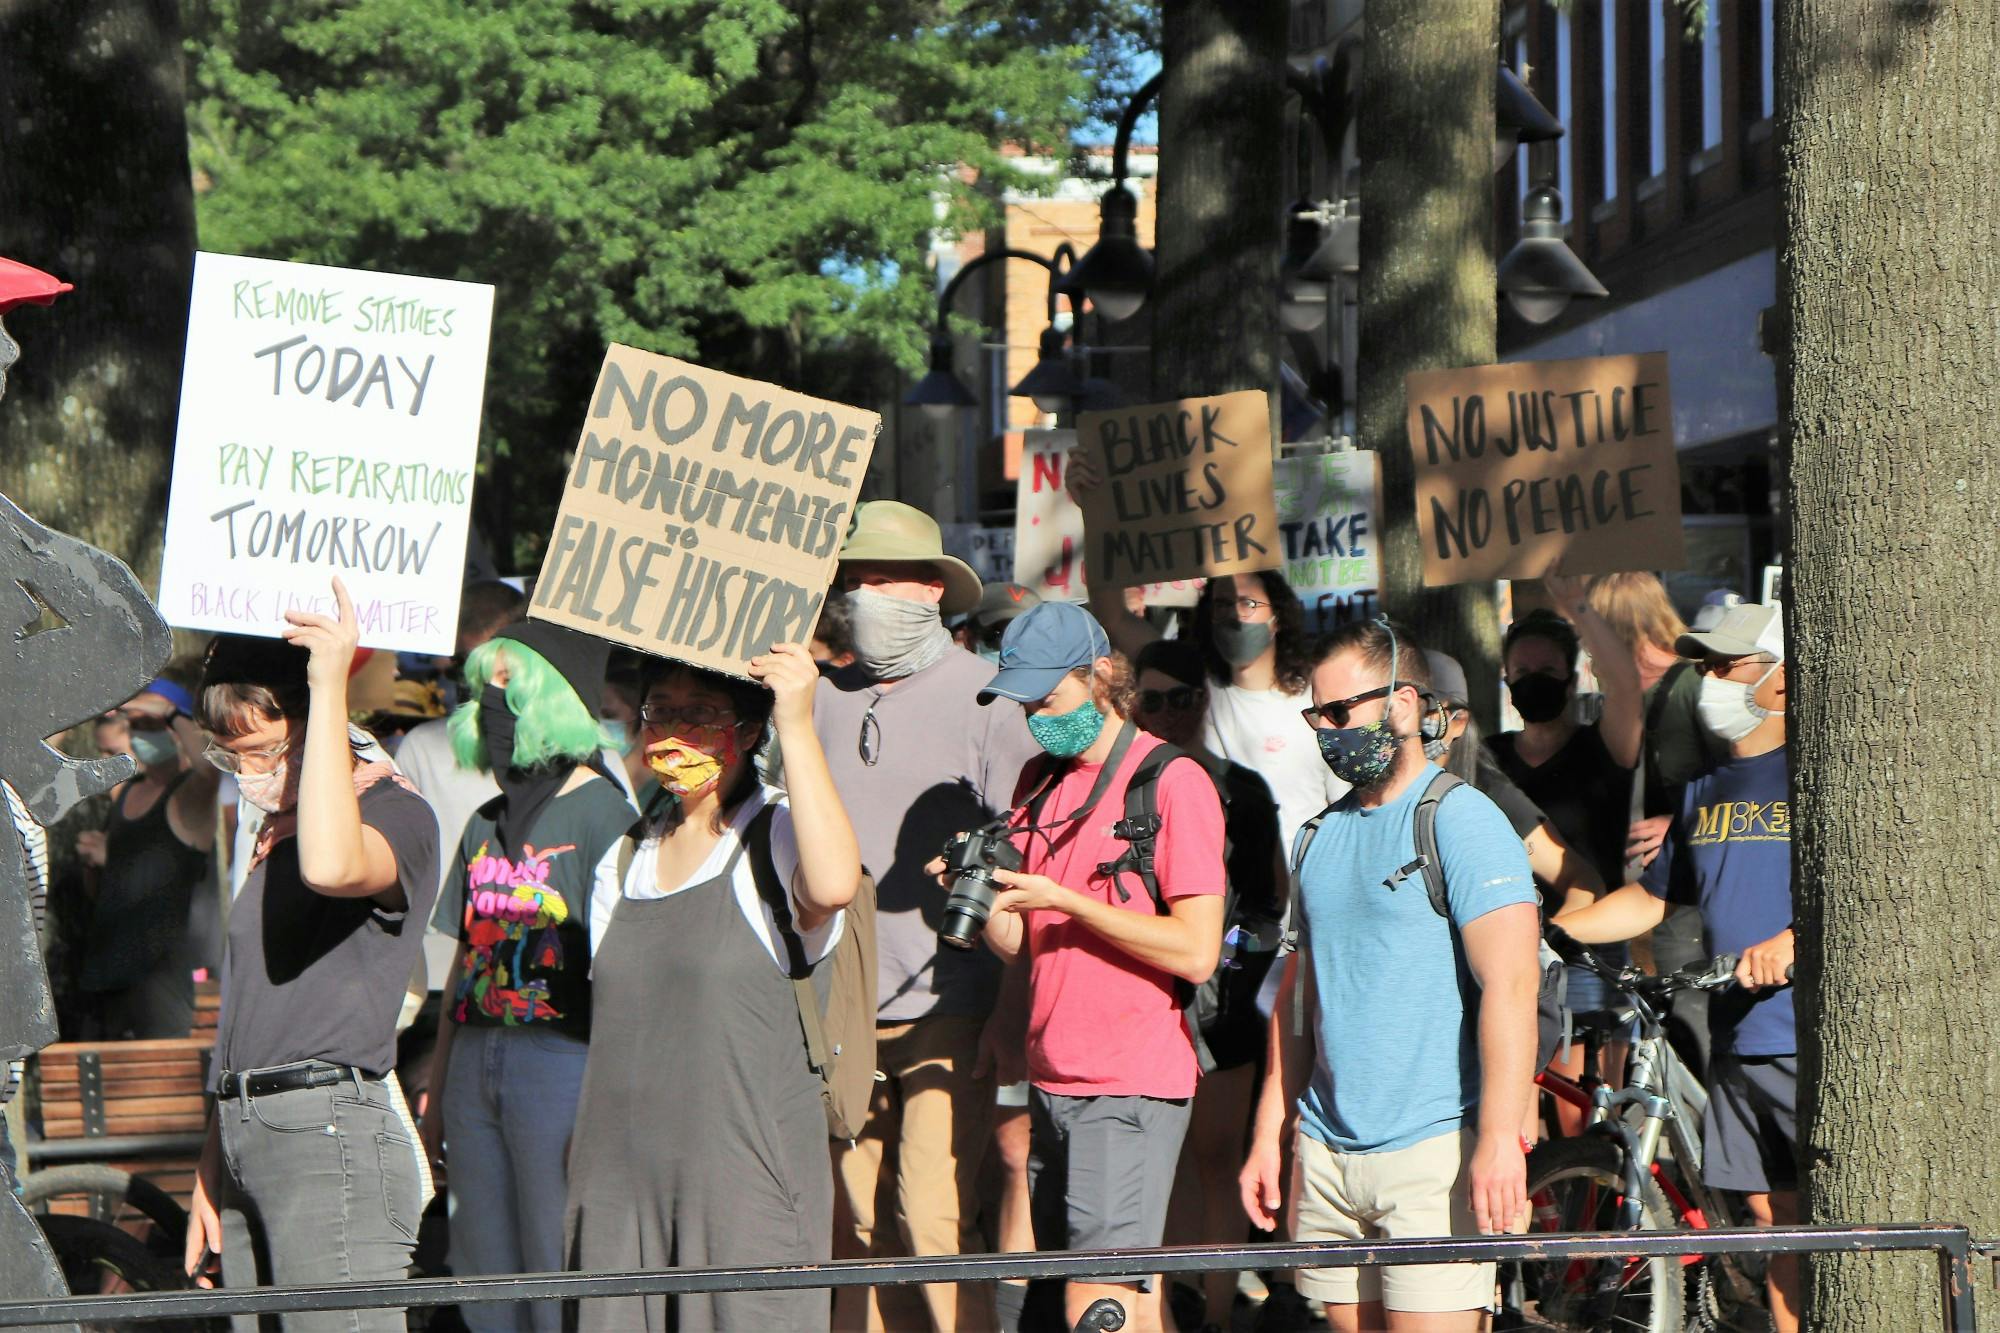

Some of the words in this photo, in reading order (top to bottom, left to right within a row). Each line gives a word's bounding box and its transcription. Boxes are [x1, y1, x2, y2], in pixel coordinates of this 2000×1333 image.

[233, 280, 344, 325] REMOVE
[354, 296, 456, 336] STATUES
[254, 334, 435, 416] TODAY
[593, 361, 708, 446] NO
[711, 391, 867, 489] MORE
[1100, 403, 1238, 475] BLACK
[1420, 394, 1487, 465] NO
[1495, 382, 1660, 457] JUSTICE
[218, 443, 273, 490] PAY
[291, 451, 469, 505] REPARATIONS
[572, 432, 848, 559] MONUMENTS
[1111, 462, 1226, 522] LIVES
[209, 500, 442, 575] TOMORROW
[664, 524, 699, 549] TO
[1102, 512, 1268, 581] MATTER
[1430, 487, 1492, 560] NO
[1503, 464, 1656, 546] PEACE
[190, 582, 261, 622] BLACK
[355, 599, 441, 634] MATTER
[534, 514, 672, 635] FALSE
[655, 552, 823, 661] HISTORY
